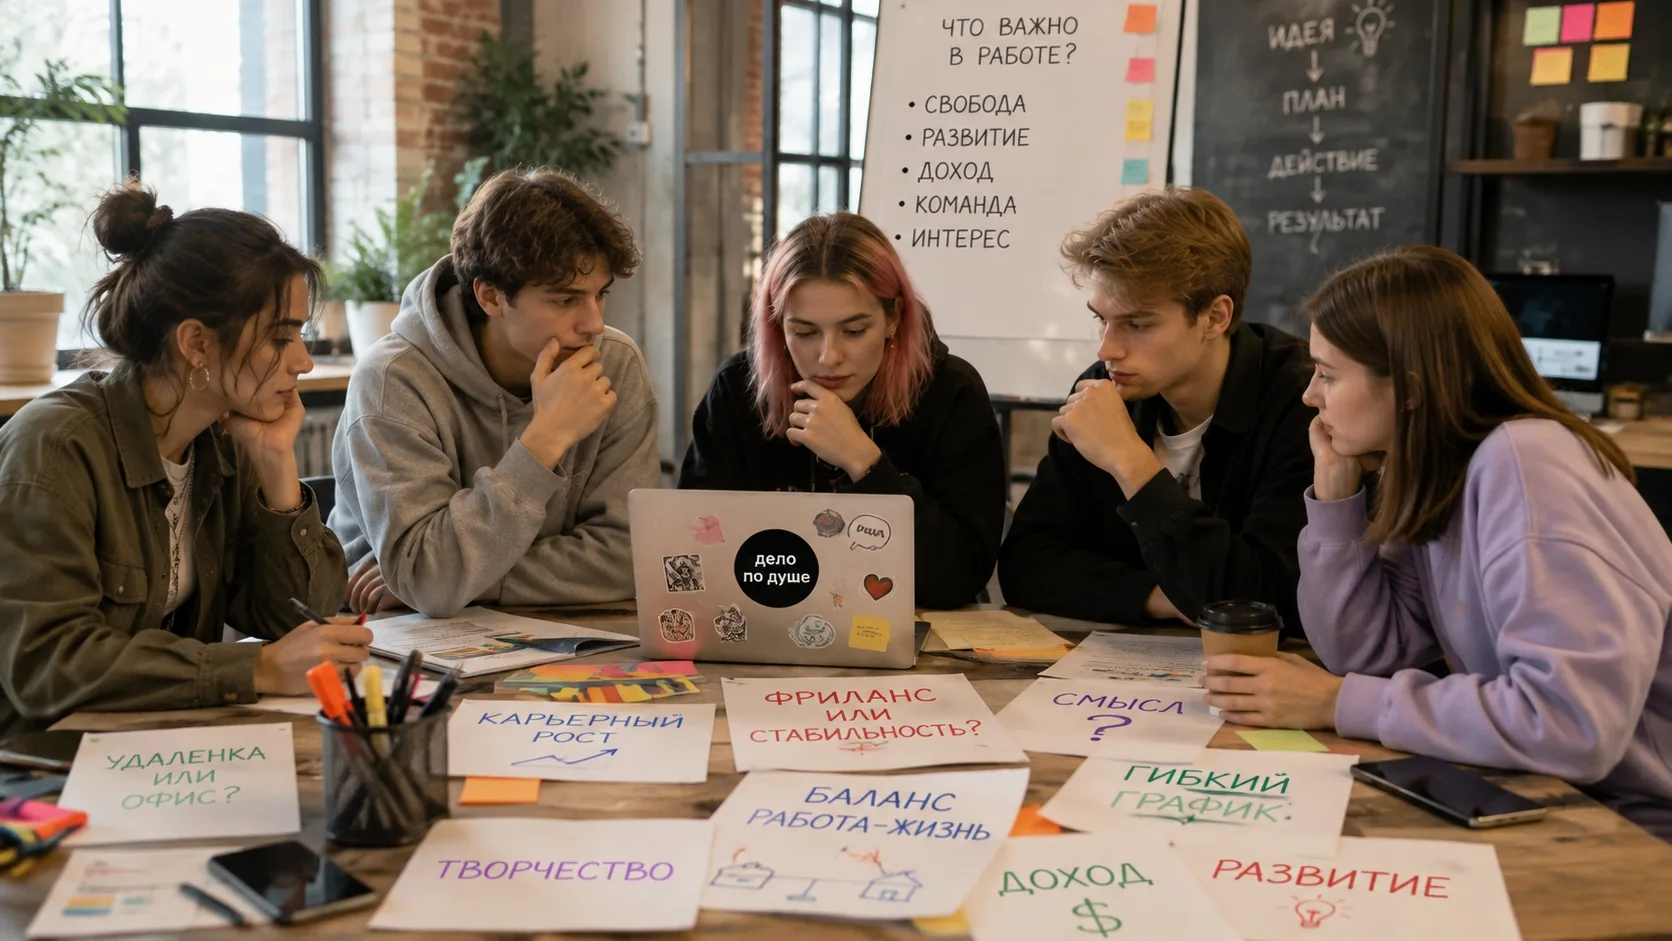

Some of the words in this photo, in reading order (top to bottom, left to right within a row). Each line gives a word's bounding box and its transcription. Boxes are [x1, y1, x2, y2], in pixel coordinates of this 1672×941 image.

[942, 18, 984, 38] ЧТО
[999, 16, 1079, 37] ВАЖНО
[1268, 18, 1335, 51] ИДЕЯ
[949, 46, 964, 65] В
[978, 42, 1077, 66] РАБОТЕ?
[924, 94, 1026, 115] СВОБОДА
[1282, 86, 1345, 115] ПЛАН
[921, 127, 1030, 148] РАЗВИТИЕ
[918, 161, 994, 183] ДОХОД
[1267, 148, 1379, 181] ДЕЙСТВИЕ
[915, 195, 1017, 217] КОМАНДА
[1267, 206, 1385, 235] РЕЗУЛЬТАТ
[912, 228, 1010, 249] ИНТЕРЕС
[755, 554, 796, 567] дело
[744, 571, 763, 583] по
[767, 572, 810, 586] душе
[764, 688, 937, 706] ФРИЛАНС
[1053, 692, 1184, 715] СМЫСЛ
[478, 711, 684, 730] КАРЬЕРНЫЙ
[826, 708, 892, 722] ИЛИ
[532, 730, 618, 745] РОСТ
[750, 719, 982, 743] СТАБИЛЬНОСТЬ?
[106, 746, 266, 771] УДАЛЕНКА
[153, 769, 215, 786] ИЛИ
[1123, 765, 1290, 794] ГИБКИЙ
[804, 786, 956, 812] БАЛАНС
[747, 808, 991, 841] РАБОТА-ЖИЗНЬ
[437, 859, 674, 883] ТВОРЧЕСТВО
[999, 862, 1153, 897] ДОХОД
[1212, 859, 1451, 899] РАЗВИТИЕ
